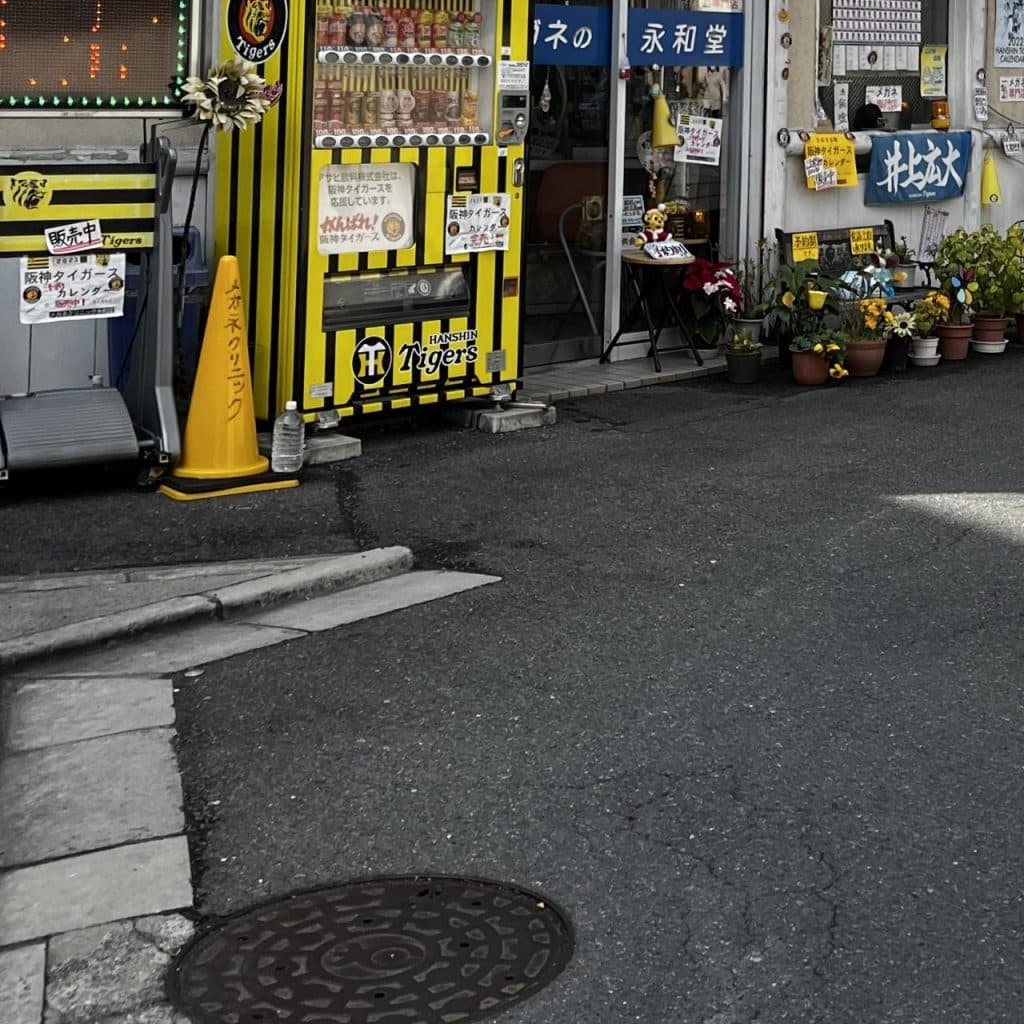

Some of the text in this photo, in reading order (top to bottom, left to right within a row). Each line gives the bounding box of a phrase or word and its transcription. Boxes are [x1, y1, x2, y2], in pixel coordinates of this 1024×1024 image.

[236, 36, 276, 60] Tigers
[640, 23, 727, 55] 永和堂
[48, 222, 96, 247] 販売中
[102, 234, 142, 247] Tigers
[24, 268, 120, 284] 阪神タイガース
[57, 286, 113, 298] カレンダー
[429, 331, 478, 345] HANSHIN
[225, 280, 245, 421] メガネクリニック
[398, 343, 478, 374] Tigers
